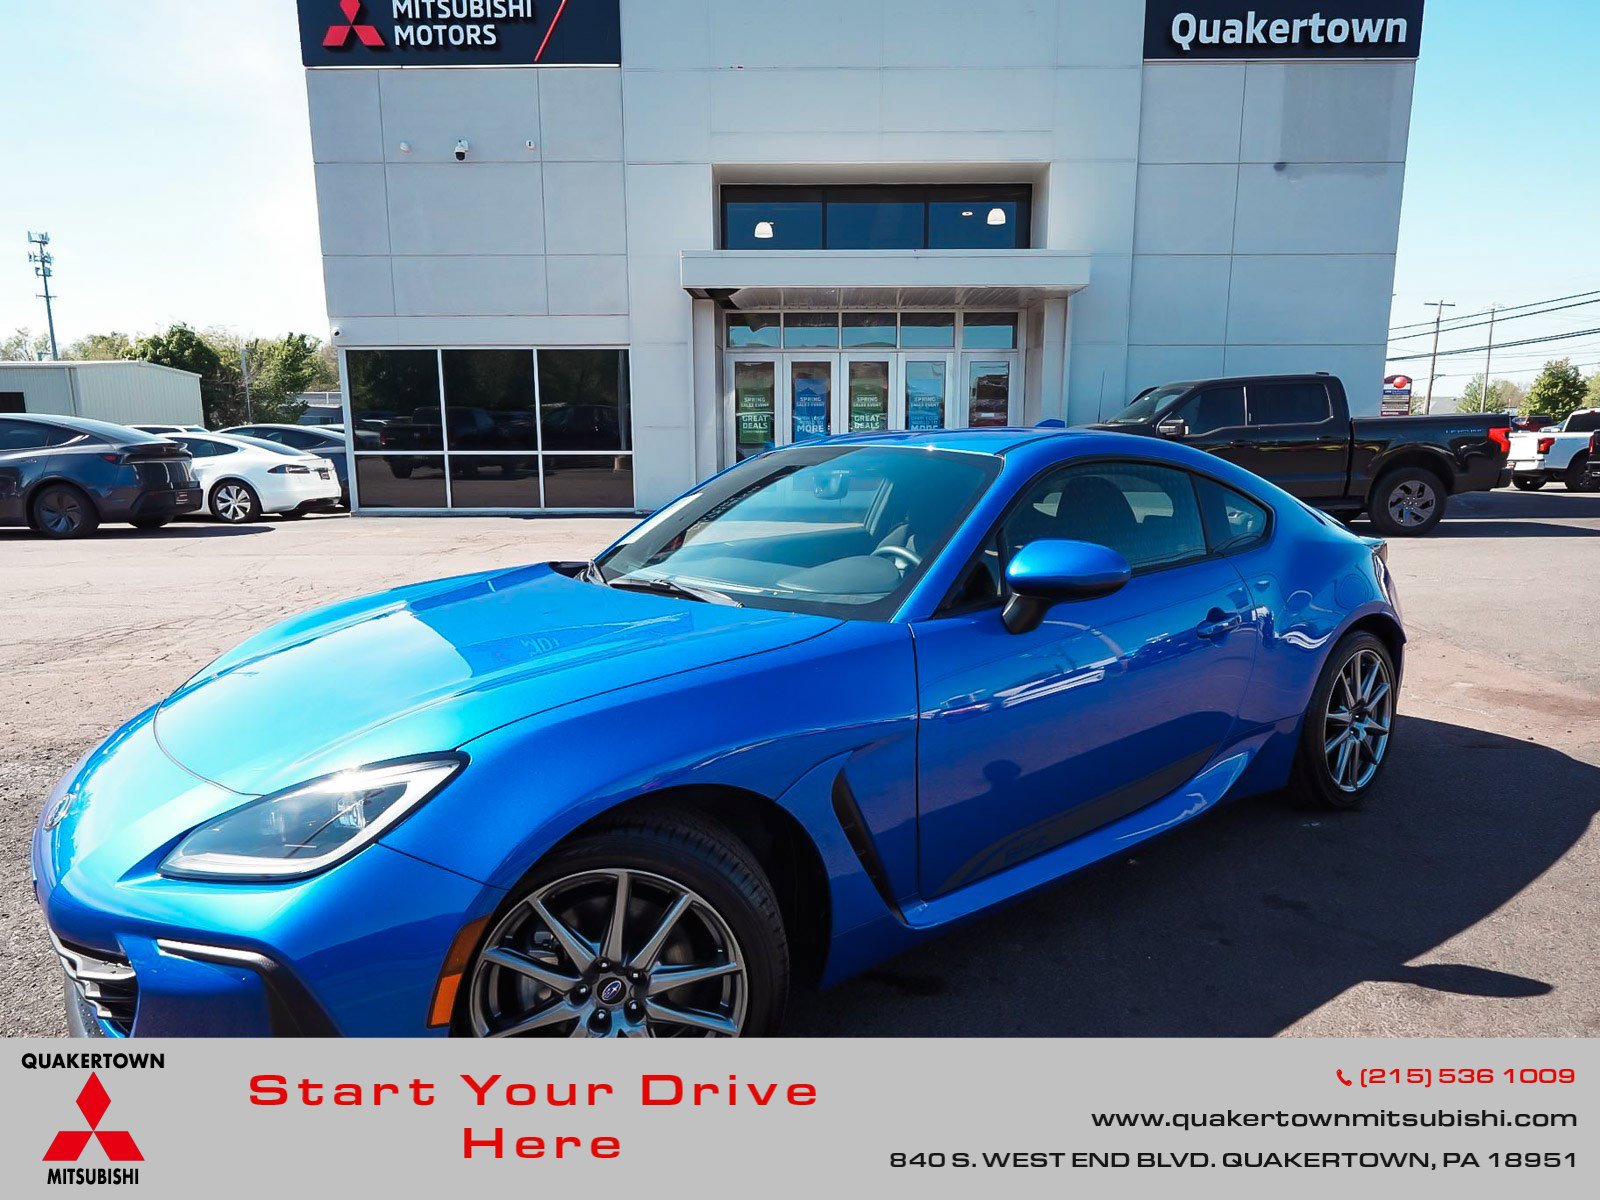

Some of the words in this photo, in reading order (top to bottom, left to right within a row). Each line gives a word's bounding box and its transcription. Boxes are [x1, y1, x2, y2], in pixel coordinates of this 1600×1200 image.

[392, 0, 532, 19] MITSUBISHI
[394, 24, 497, 46] MOTORS
[1171, 11, 1408, 51] Quakertown
[797, 424, 824, 432] MORE
